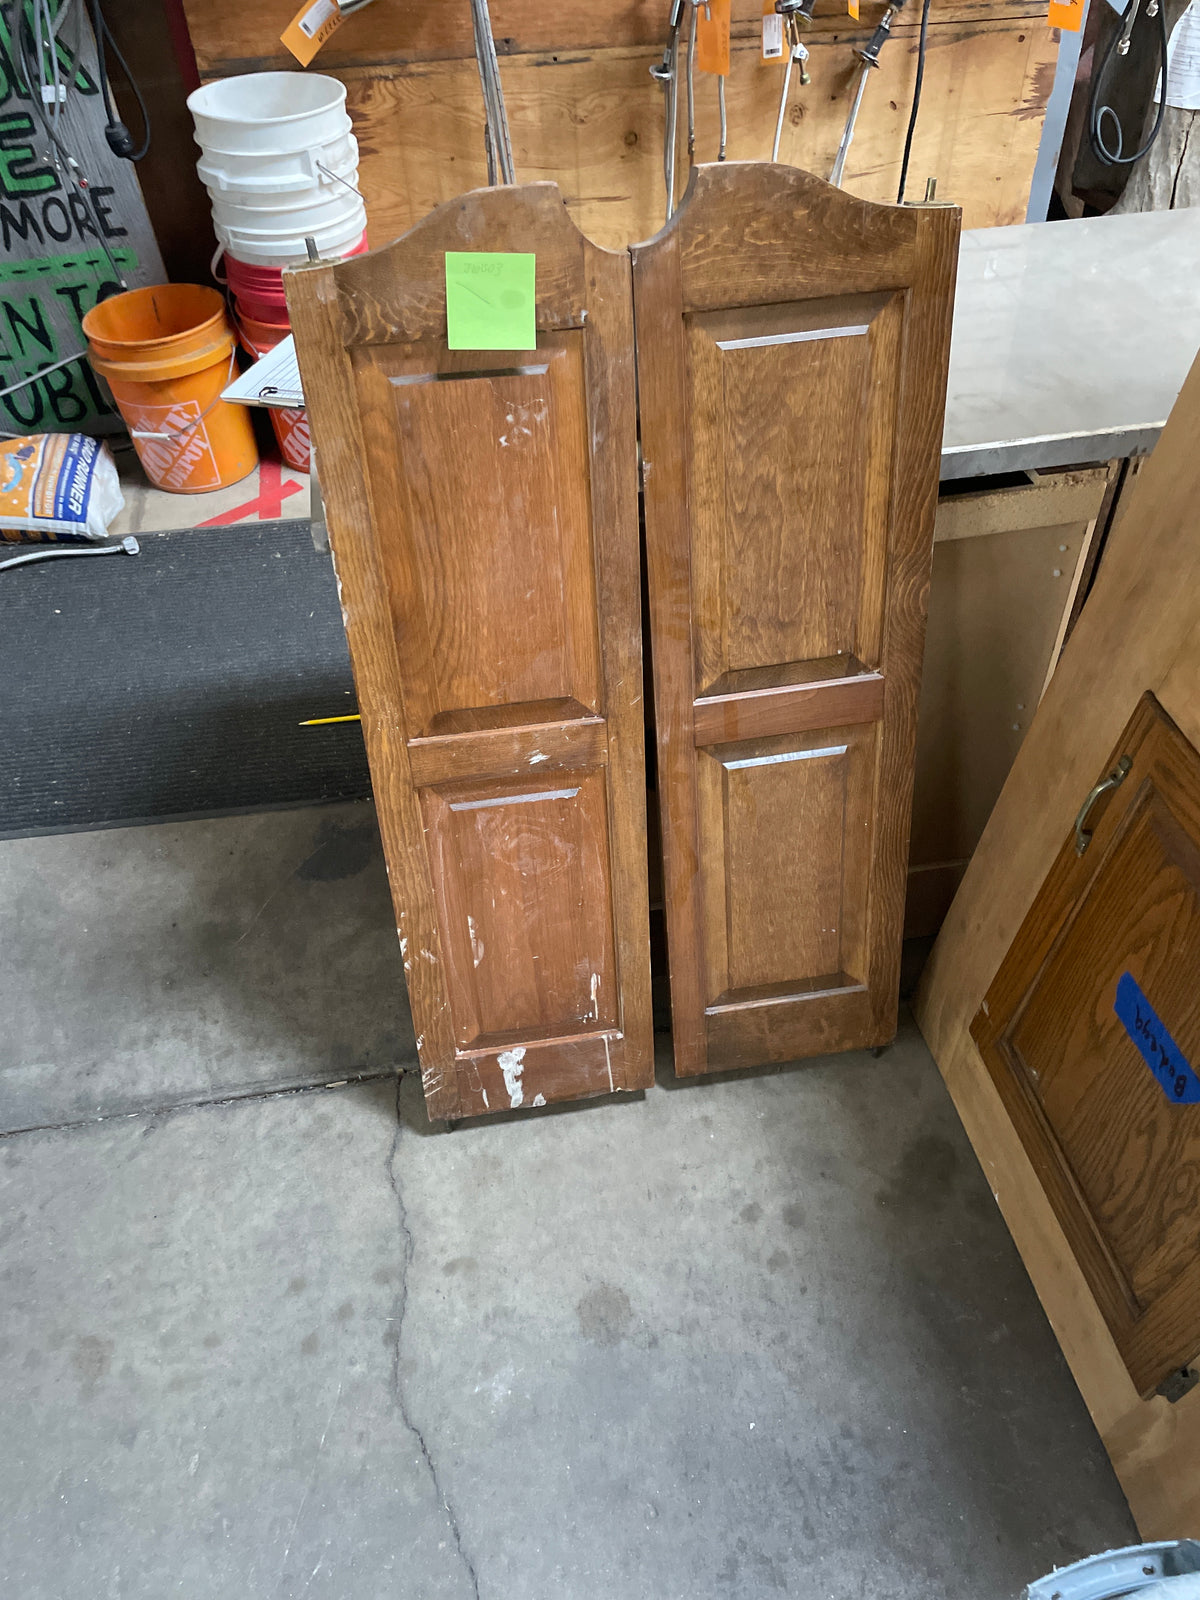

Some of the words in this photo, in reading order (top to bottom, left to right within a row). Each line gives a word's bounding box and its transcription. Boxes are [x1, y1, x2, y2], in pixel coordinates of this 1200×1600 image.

[0, 186, 128, 252] MORE
[68, 457, 91, 516] RUNNER
[166, 434, 209, 488] DEPOT
